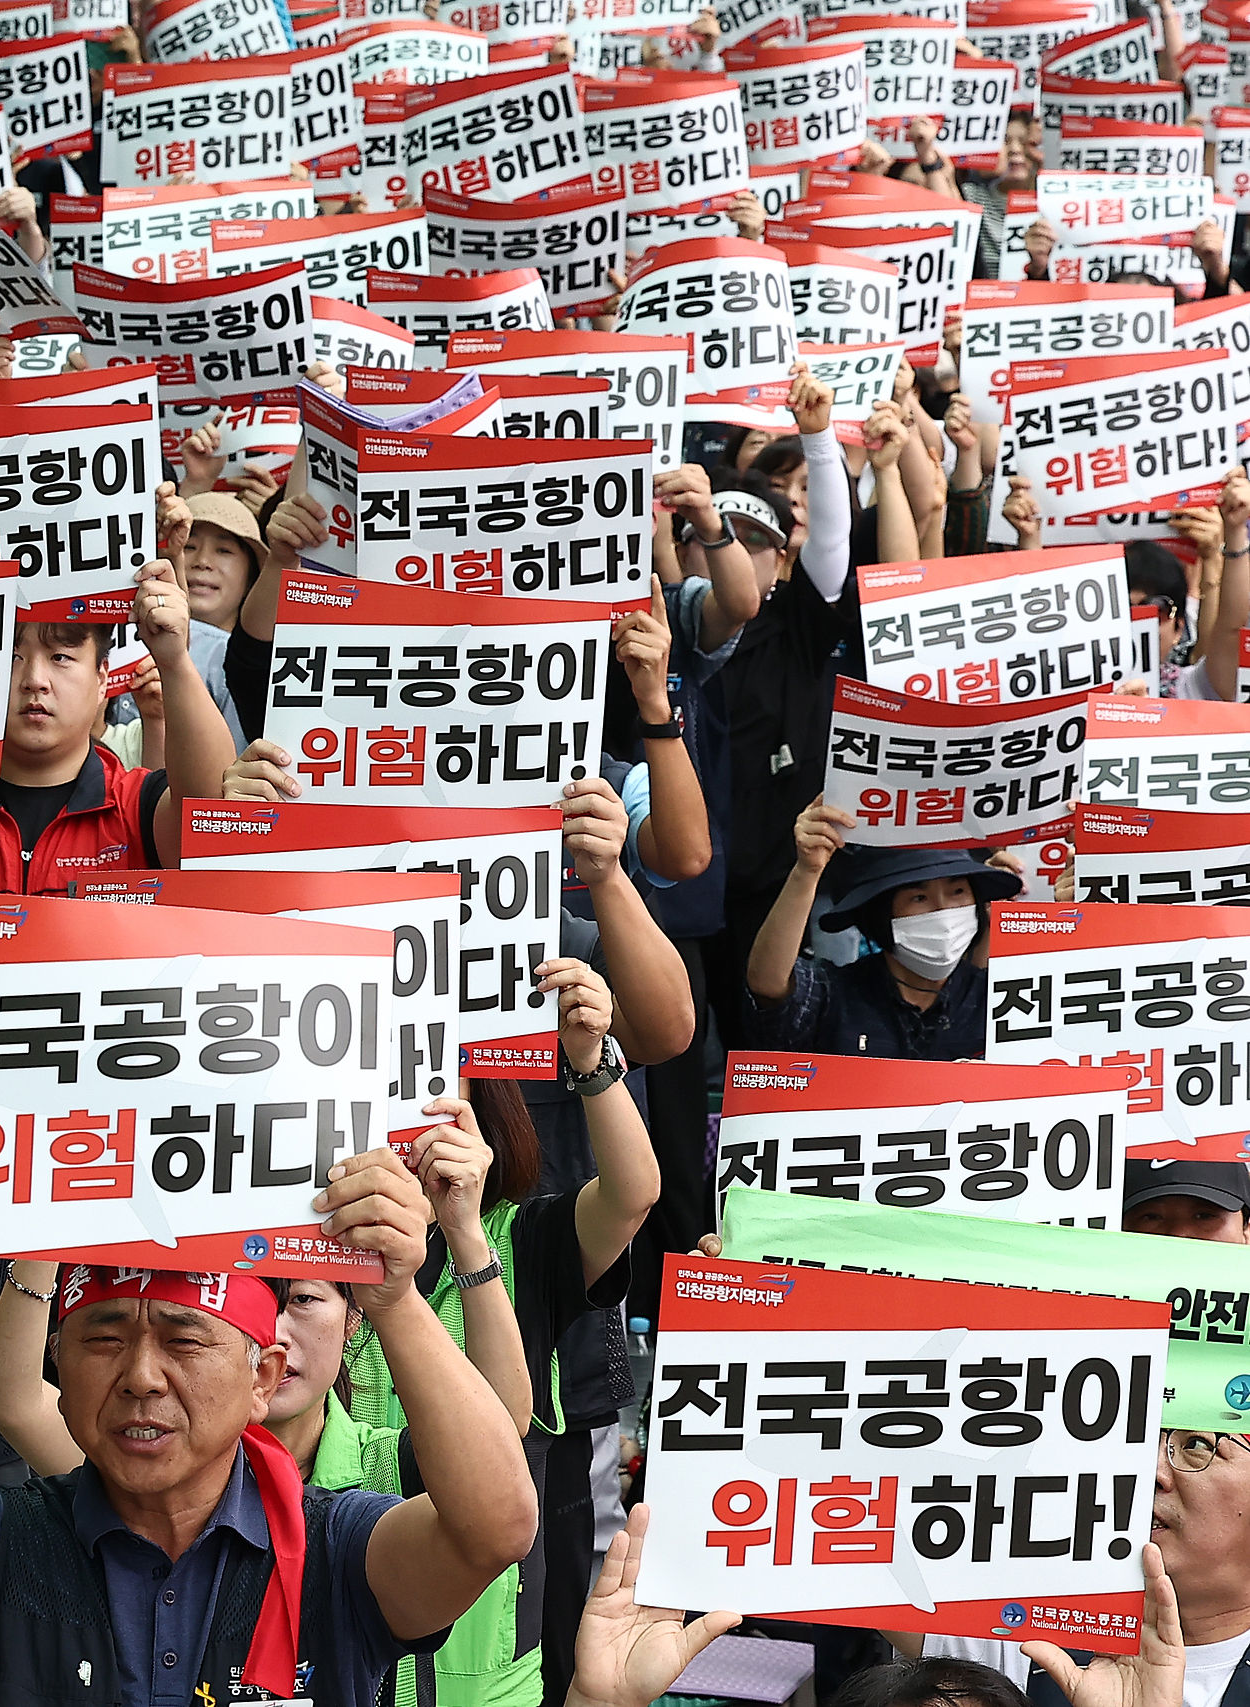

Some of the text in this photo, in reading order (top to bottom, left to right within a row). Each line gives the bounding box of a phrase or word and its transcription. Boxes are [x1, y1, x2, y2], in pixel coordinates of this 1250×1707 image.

[865, 38, 949, 68] 공항이
[116, 86, 286, 141] 전국공항이
[873, 75, 944, 103] 하다!
[7, 92, 84, 138] 하다!
[405, 83, 574, 166] 전국공항이
[585, 102, 738, 157] 전국공항이
[136, 131, 283, 181] 위험하다!
[428, 211, 621, 261] 전국공항이
[1061, 195, 1205, 229] 위험하다!
[306, 231, 423, 292] 공항이
[78, 288, 307, 346] 전국공항이
[966, 310, 1166, 358] 전국공항이
[1015, 372, 1227, 449] 전국공항이
[364, 444, 428, 457] 인천공항지역지부
[1046, 426, 1228, 495] 위험하다!
[360, 468, 644, 541] 전국공항이
[89, 599, 134, 608] 전국공항노
[286, 589, 352, 608] 인천공항지역지부
[867, 573, 1122, 665] 전국공항이
[271, 639, 596, 709] 전국공항이
[297, 721, 589, 787] 위험하다!
[1088, 751, 1250, 807] 전국공
[856, 765, 1078, 829] 위험하다
[191, 819, 272, 835] 인천공항지역지부
[1083, 821, 1149, 836] 인천공항지역지부
[1000, 921, 1076, 934] 인천공항지역지부
[992, 956, 1250, 1044] 전국공항
[472, 1048, 553, 1060] 전국공항노동조합
[732, 1074, 809, 1091] 인천공항지역지부
[718, 1113, 1114, 1209] 전국공항이
[274, 1250, 302, 1261] National
[303, 1253, 329, 1264] Airport
[678, 1269, 743, 1284] 민주노총 공공운수노조
[675, 1281, 784, 1307] 인천공항지역지부
[658, 1355, 1152, 1452] 전국공항이
[705, 1473, 1138, 1568] 위험하다!
[1031, 1605, 1138, 1629] 전국공항노동조합
[1031, 1619, 1136, 1639] National Airport Worker's Union
